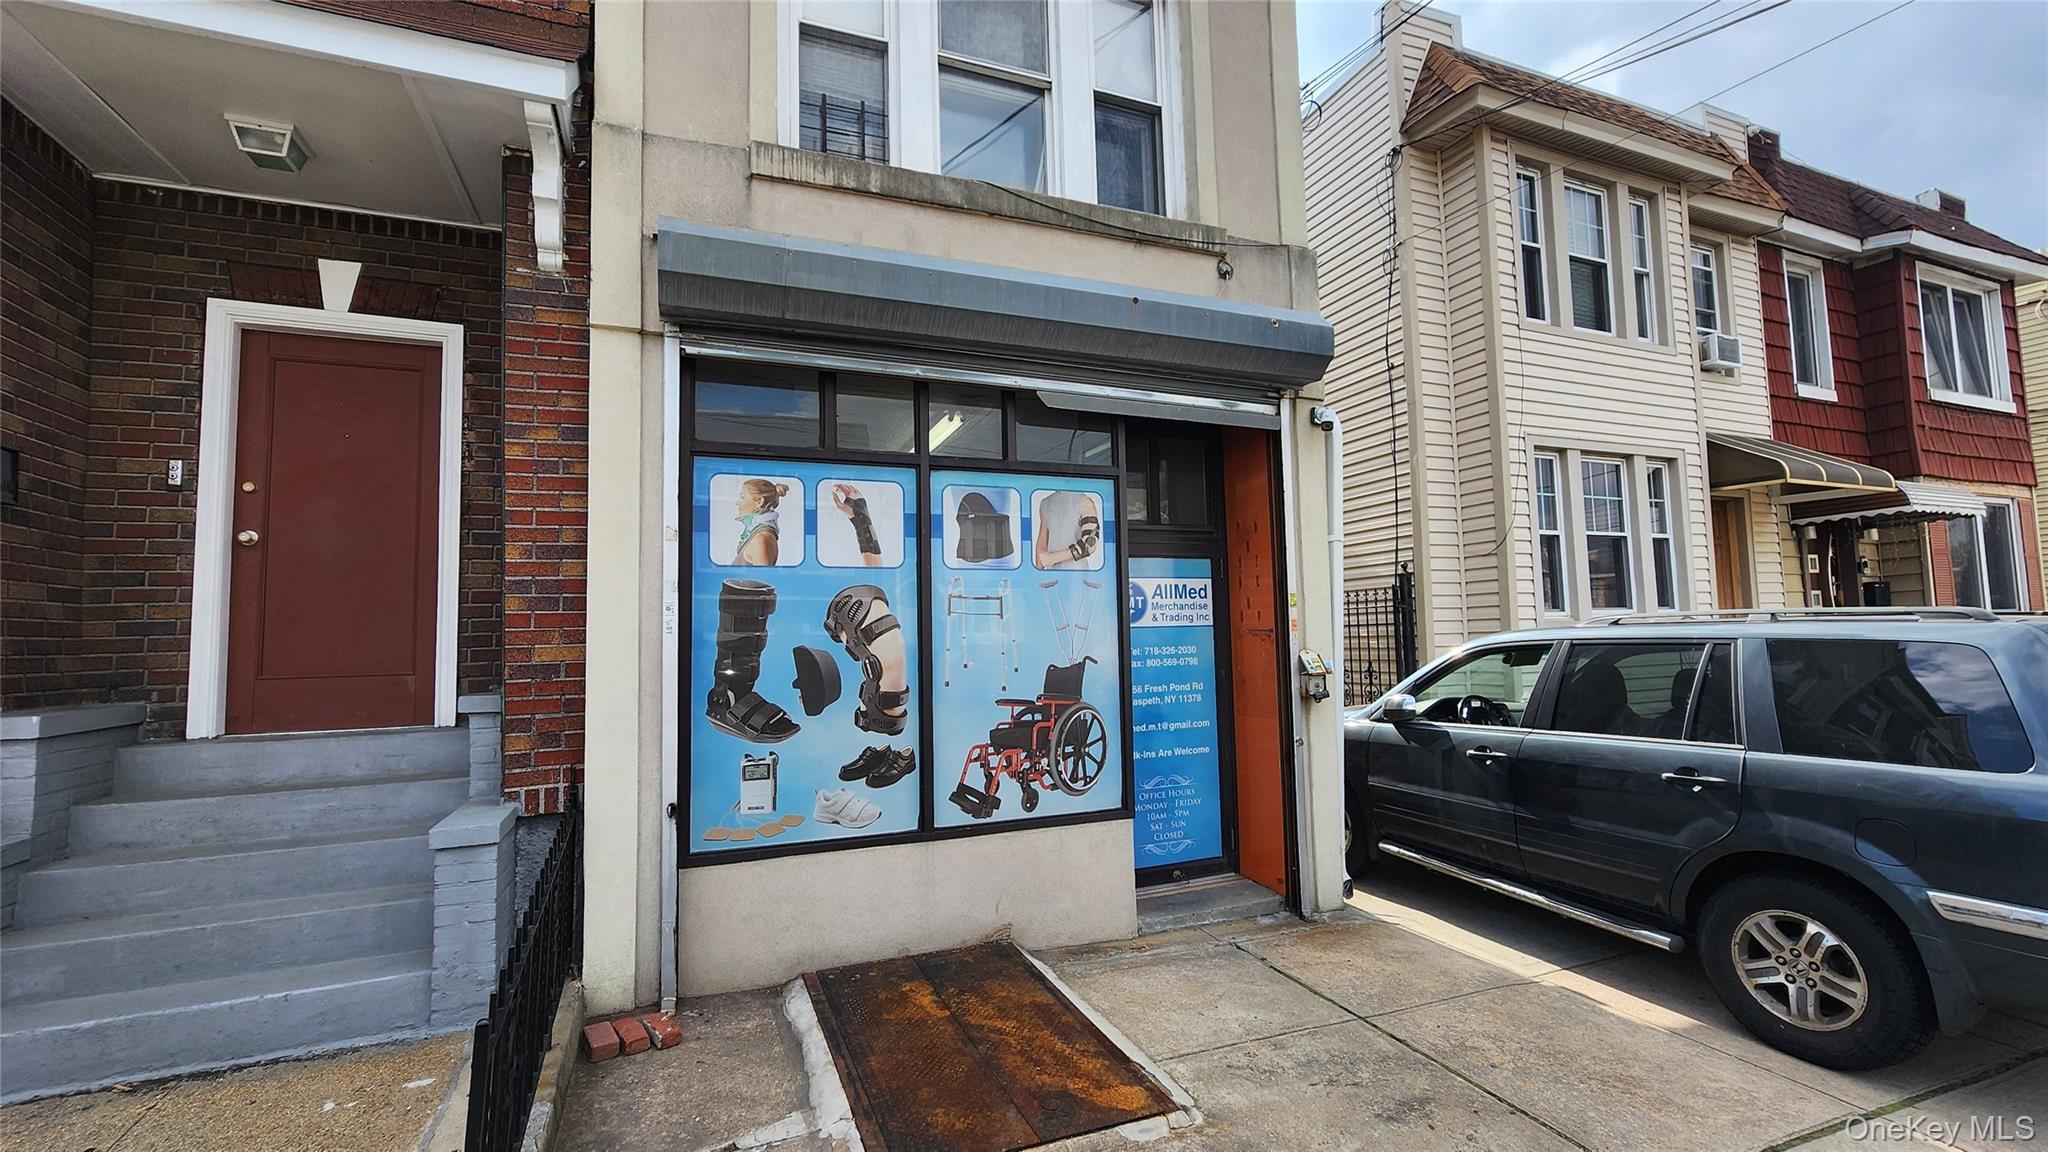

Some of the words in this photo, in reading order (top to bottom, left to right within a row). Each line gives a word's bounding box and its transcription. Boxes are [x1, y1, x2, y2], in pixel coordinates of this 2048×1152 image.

[1151, 583, 1208, 600] AllMed
[1129, 597, 1145, 608] MT
[1151, 601, 1209, 611] Merchandise
[1151, 614, 1158, 622] &
[1160, 612, 1194, 623] Trading
[1196, 612, 1210, 621] Inc
[1131, 660, 1145, 668] ax:
[1132, 685, 1143, 694] 56
[1144, 683, 1168, 693] Fresh
[1169, 682, 1190, 692] Pond
[1192, 682, 1204, 691] Rd
[1132, 696, 1163, 707] aspeth,
[1164, 695, 1177, 704] NY
[1179, 694, 1202, 703] 11378
[1133, 751, 1156, 760] lk-Ins
[1158, 748, 1173, 758] Are
[1173, 746, 1211, 756] Welcome
[1138, 791, 1167, 801] OFFICE
[1168, 788, 1195, 798] HOURS
[1175, 798, 1202, 807] FRIDAY
[1147, 812, 1167, 821] 10AM
[1174, 809, 1190, 818] 5PM
[1150, 822, 1164, 831] SAT
[1170, 820, 1186, 829] SUN
[1153, 830, 1184, 841] CLOSED
